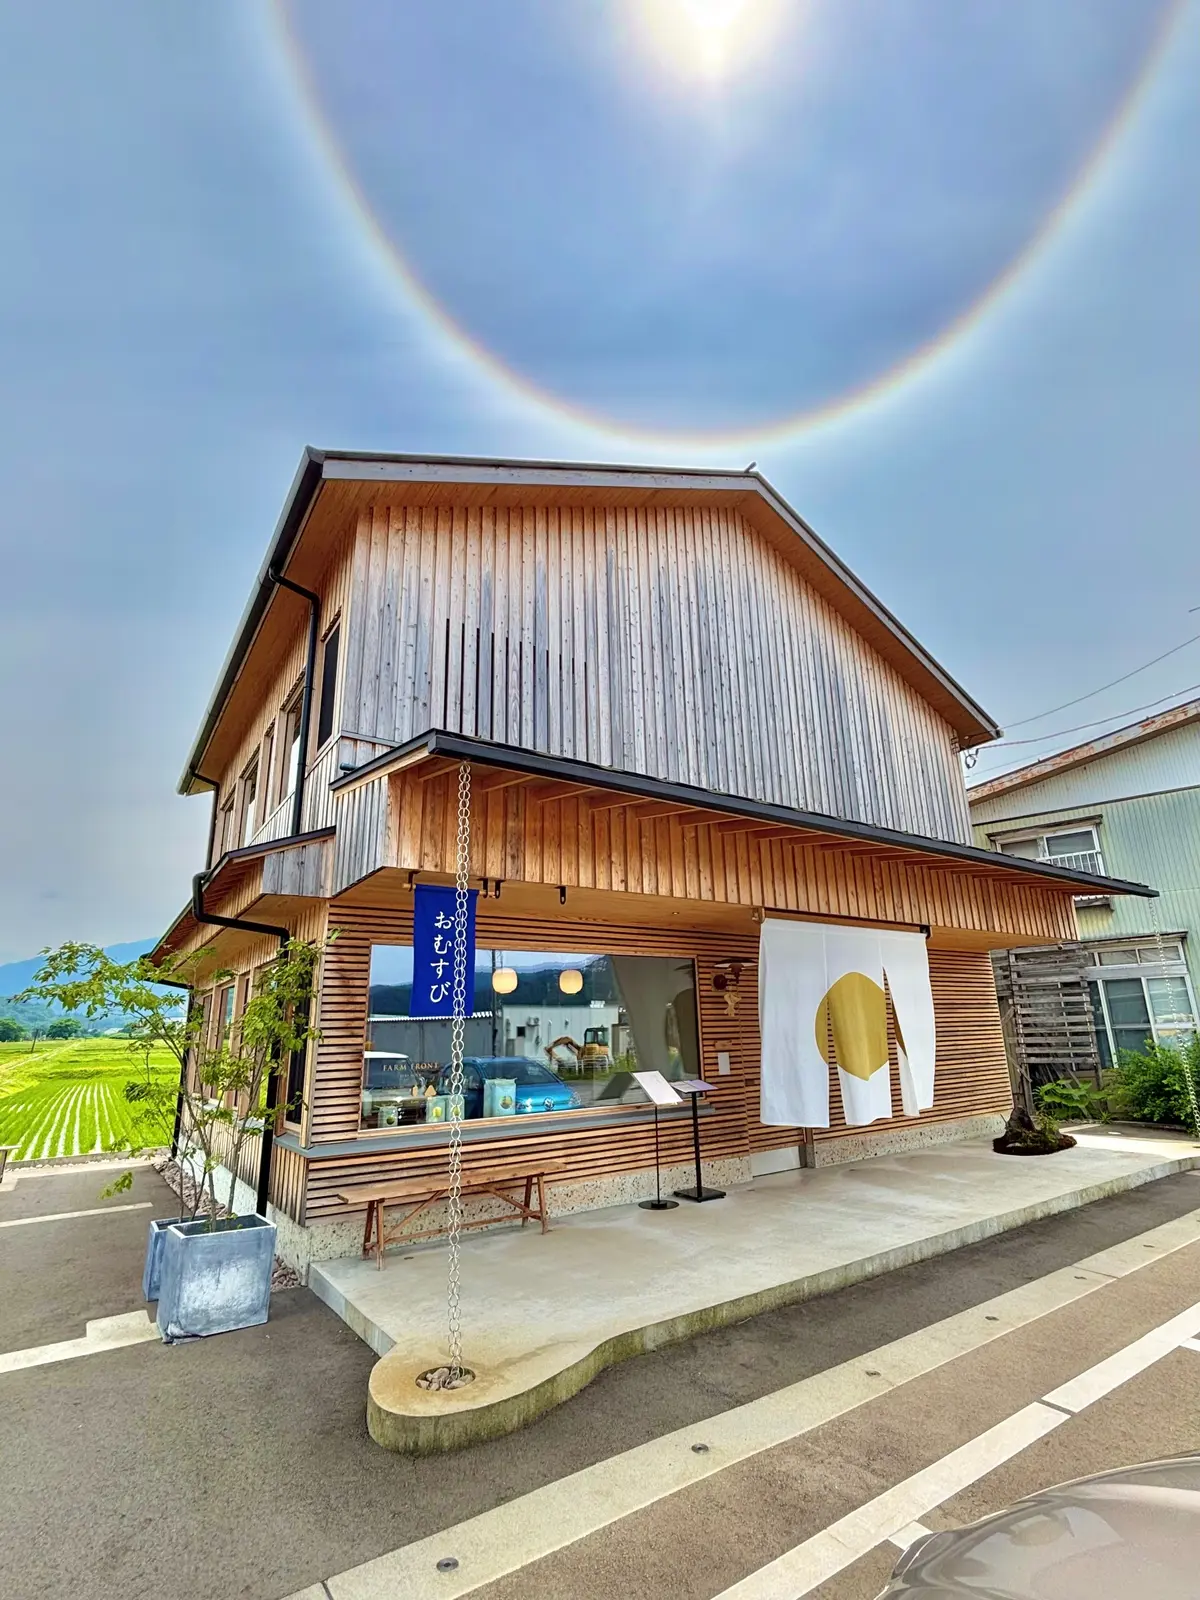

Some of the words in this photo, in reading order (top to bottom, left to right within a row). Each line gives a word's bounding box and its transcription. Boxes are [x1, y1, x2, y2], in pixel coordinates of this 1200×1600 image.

[430, 911, 455, 1003] おむすび
[383, 1064, 407, 1072] FARM
[411, 1062, 438, 1071] FRONT
